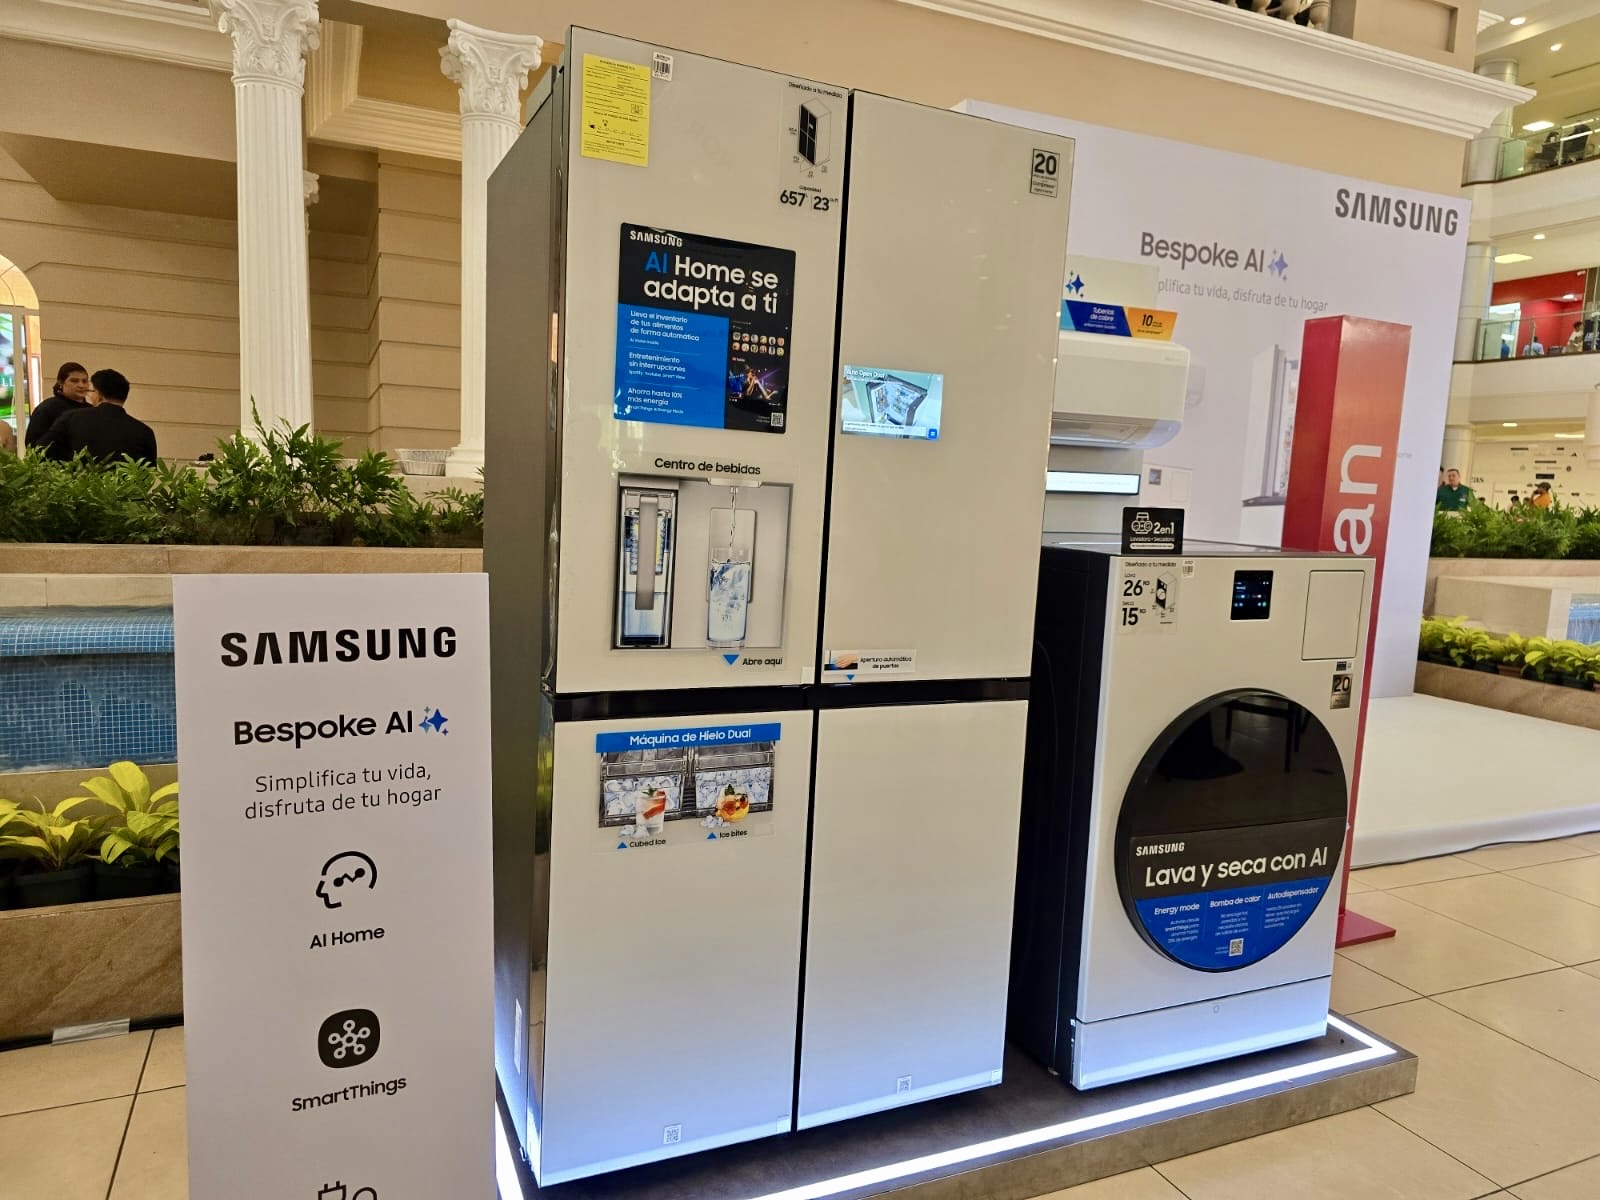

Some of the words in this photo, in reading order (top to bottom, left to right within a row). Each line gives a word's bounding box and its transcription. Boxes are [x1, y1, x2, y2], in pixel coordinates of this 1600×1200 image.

[1034, 153, 1057, 175] 20
[780, 190, 805, 207] 657
[813, 196, 830, 211] 23
[1335, 188, 1459, 236] SAMSUNG
[630, 230, 682, 247] SAMSUNG
[1140, 232, 1239, 270] Bespoke
[1244, 248, 1264, 273] AI
[644, 251, 668, 273] AI
[675, 255, 745, 284] Home
[751, 270, 778, 288] se
[644, 280, 734, 310] adapta
[741, 294, 756, 311] a
[763, 292, 778, 314] ti
[1158, 278, 1191, 295] plifica
[1194, 283, 1204, 296] tu
[1206, 285, 1230, 300] vida,
[1233, 288, 1271, 306] disfruta
[1274, 292, 1286, 308] de
[1289, 295, 1299, 309] tu
[1301, 295, 1328, 313] hogar
[630, 310, 647, 318] Lleva
[656, 313, 687, 323] inventario
[1142, 314, 1153, 326] 10
[640, 328, 660, 336] forma
[652, 322, 683, 331] alimentos
[629, 352, 680, 363] Entretenimiento
[639, 361, 686, 372] interrupciones
[652, 389, 670, 397] hasta
[654, 458, 695, 471] Centro
[698, 460, 713, 472] de
[716, 462, 761, 475] bebidas
[1123, 580, 1143, 596] 26
[1122, 608, 1138, 626] 15
[220, 626, 456, 667] SAMSUNG
[742, 658, 760, 666] Abre
[762, 657, 783, 668] aquí
[1334, 676, 1350, 692] 20
[234, 714, 376, 749] Bespoke
[385, 710, 412, 734] AI
[630, 734, 679, 746] Máquina
[682, 733, 697, 742] de
[700, 730, 726, 740] Hielo
[728, 729, 751, 739] Dual
[255, 770, 356, 793] Simplifica
[363, 766, 382, 783] tu
[388, 762, 431, 781] vida,
[245, 795, 325, 819] disfruta
[332, 794, 355, 810] de
[361, 792, 380, 807] tu
[388, 786, 441, 806] hogar
[720, 831, 729, 839] Ice
[731, 830, 747, 838] bites
[629, 840, 652, 848] Cubed
[1136, 842, 1185, 857] SAMSUNG
[1145, 865, 1196, 887] Lava
[1201, 863, 1213, 887] y
[1218, 857, 1266, 879] seca
[1270, 852, 1306, 871] con
[1310, 847, 1328, 866] AI
[1268, 887, 1319, 900] Autodispensador
[1154, 906, 1178, 915] Energy
[1180, 903, 1200, 912] mode
[1210, 899, 1234, 908] Bomba
[310, 933, 326, 949] AI
[332, 926, 385, 946] Home
[292, 1077, 406, 1112] SmartThings
